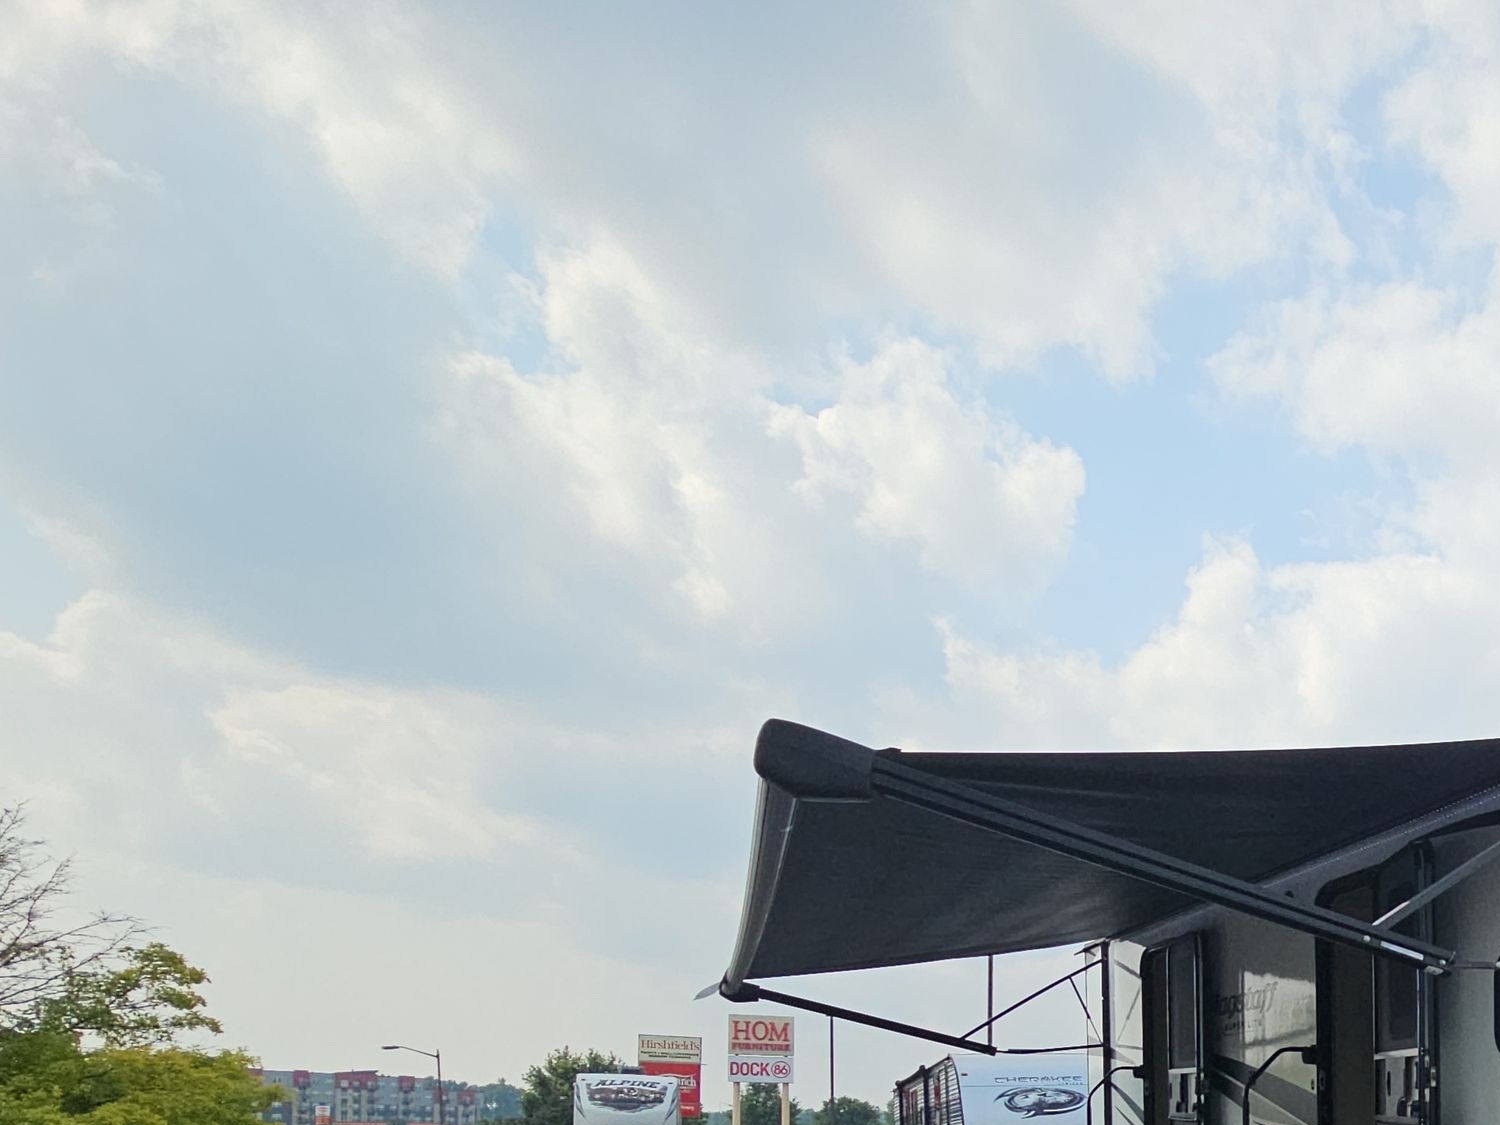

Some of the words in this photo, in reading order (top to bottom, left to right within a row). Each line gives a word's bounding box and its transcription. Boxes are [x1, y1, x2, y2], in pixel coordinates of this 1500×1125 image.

[732, 1020, 790, 1042] HOM
[639, 1039, 700, 1051] Hirshfield's
[731, 1042, 791, 1052] FURNITURE
[730, 1061, 770, 1077] DOCK
[773, 1064, 788, 1075] 86
[595, 1079, 661, 1089] ALPINE
